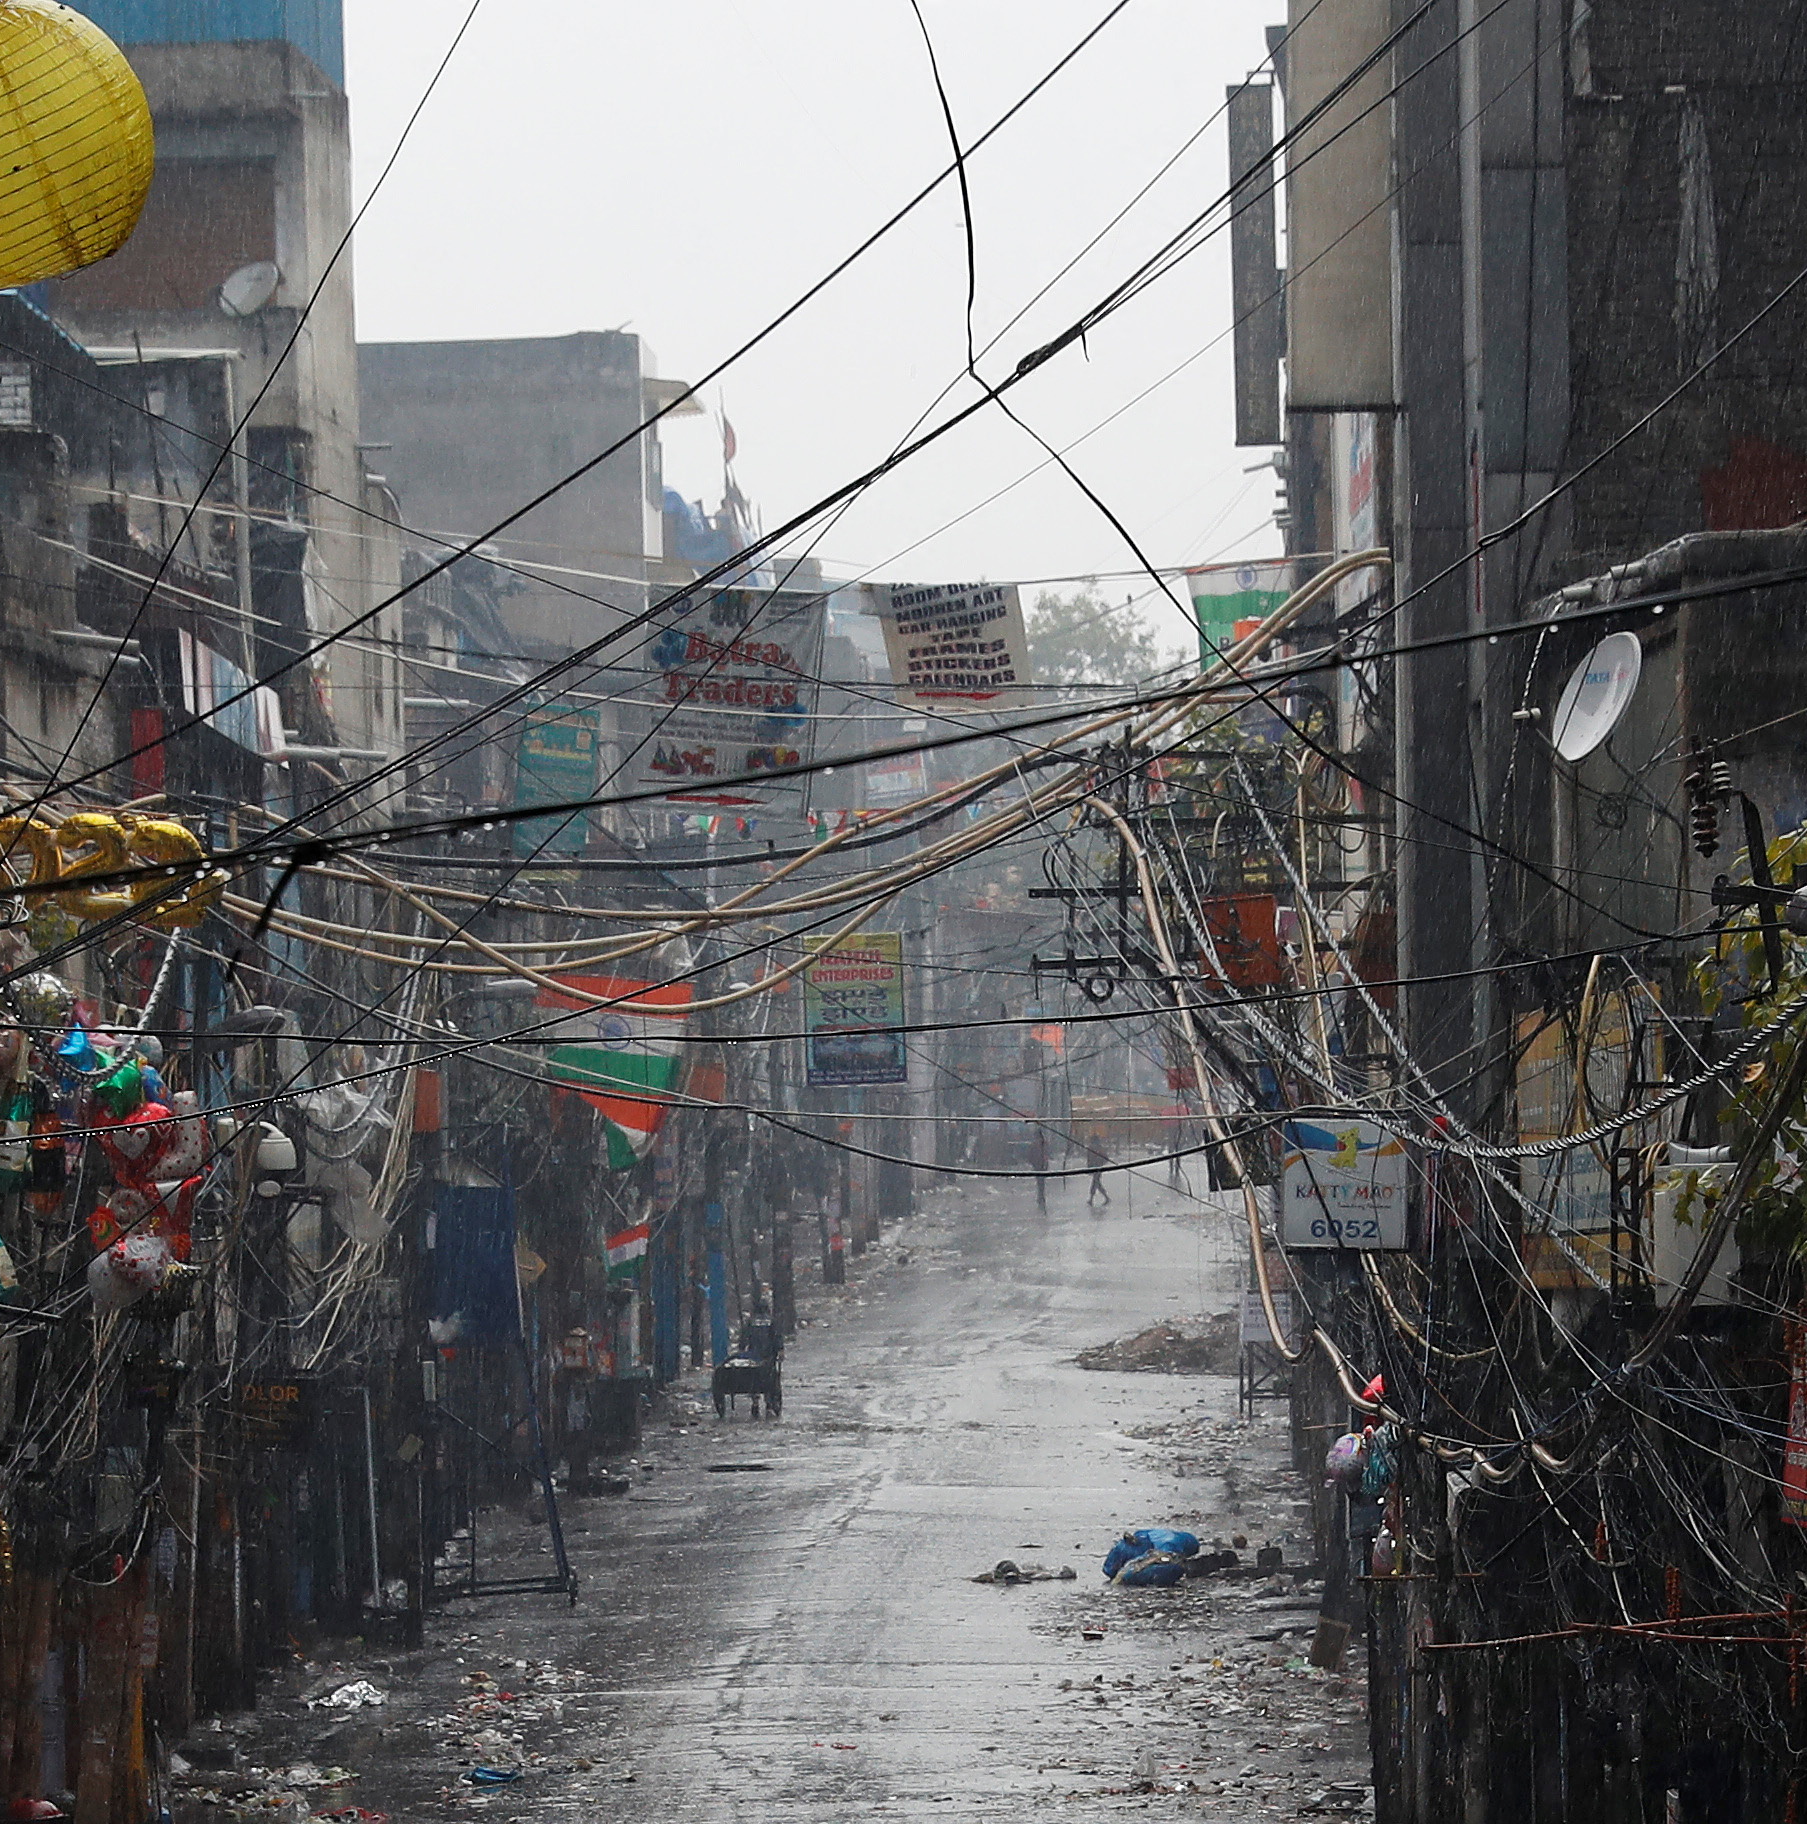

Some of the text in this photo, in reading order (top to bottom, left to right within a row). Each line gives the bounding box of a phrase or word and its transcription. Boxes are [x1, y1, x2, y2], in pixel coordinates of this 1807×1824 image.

[972, 588, 1004, 608] ART
[685, 632, 782, 666] Batra
[908, 652, 1012, 672] STICKERS
[663, 672, 799, 707] Traders
[812, 967, 896, 984] ENTERPRISES
[1311, 1219, 1378, 1238] 6052
